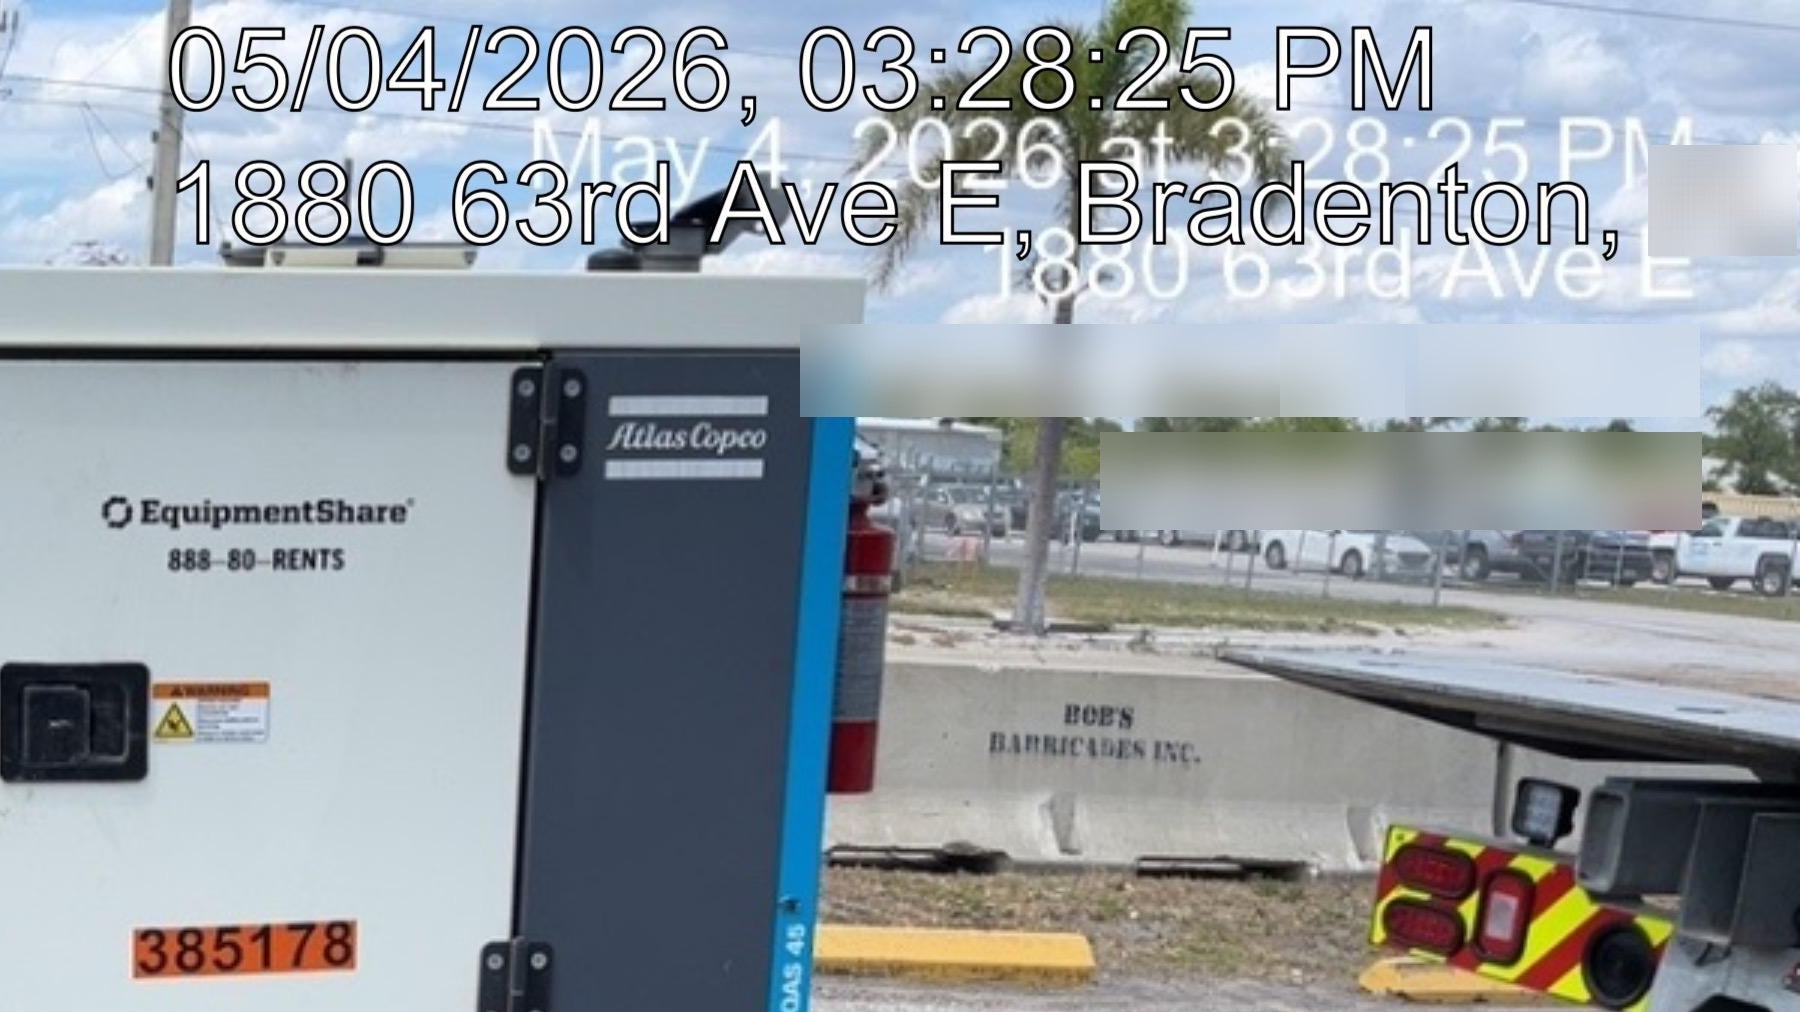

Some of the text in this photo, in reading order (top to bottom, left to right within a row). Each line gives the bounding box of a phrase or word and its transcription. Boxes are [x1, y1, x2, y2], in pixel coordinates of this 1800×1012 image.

[606, 421, 768, 456] Atlas Copco
[140, 498, 409, 530] EquipmentShare
[167, 548, 346, 572] 888-80-RENTS
[1063, 703, 1135, 730] BOB'S
[989, 731, 1202, 764] BARRICADES INC.
[137, 921, 353, 974] 385178
